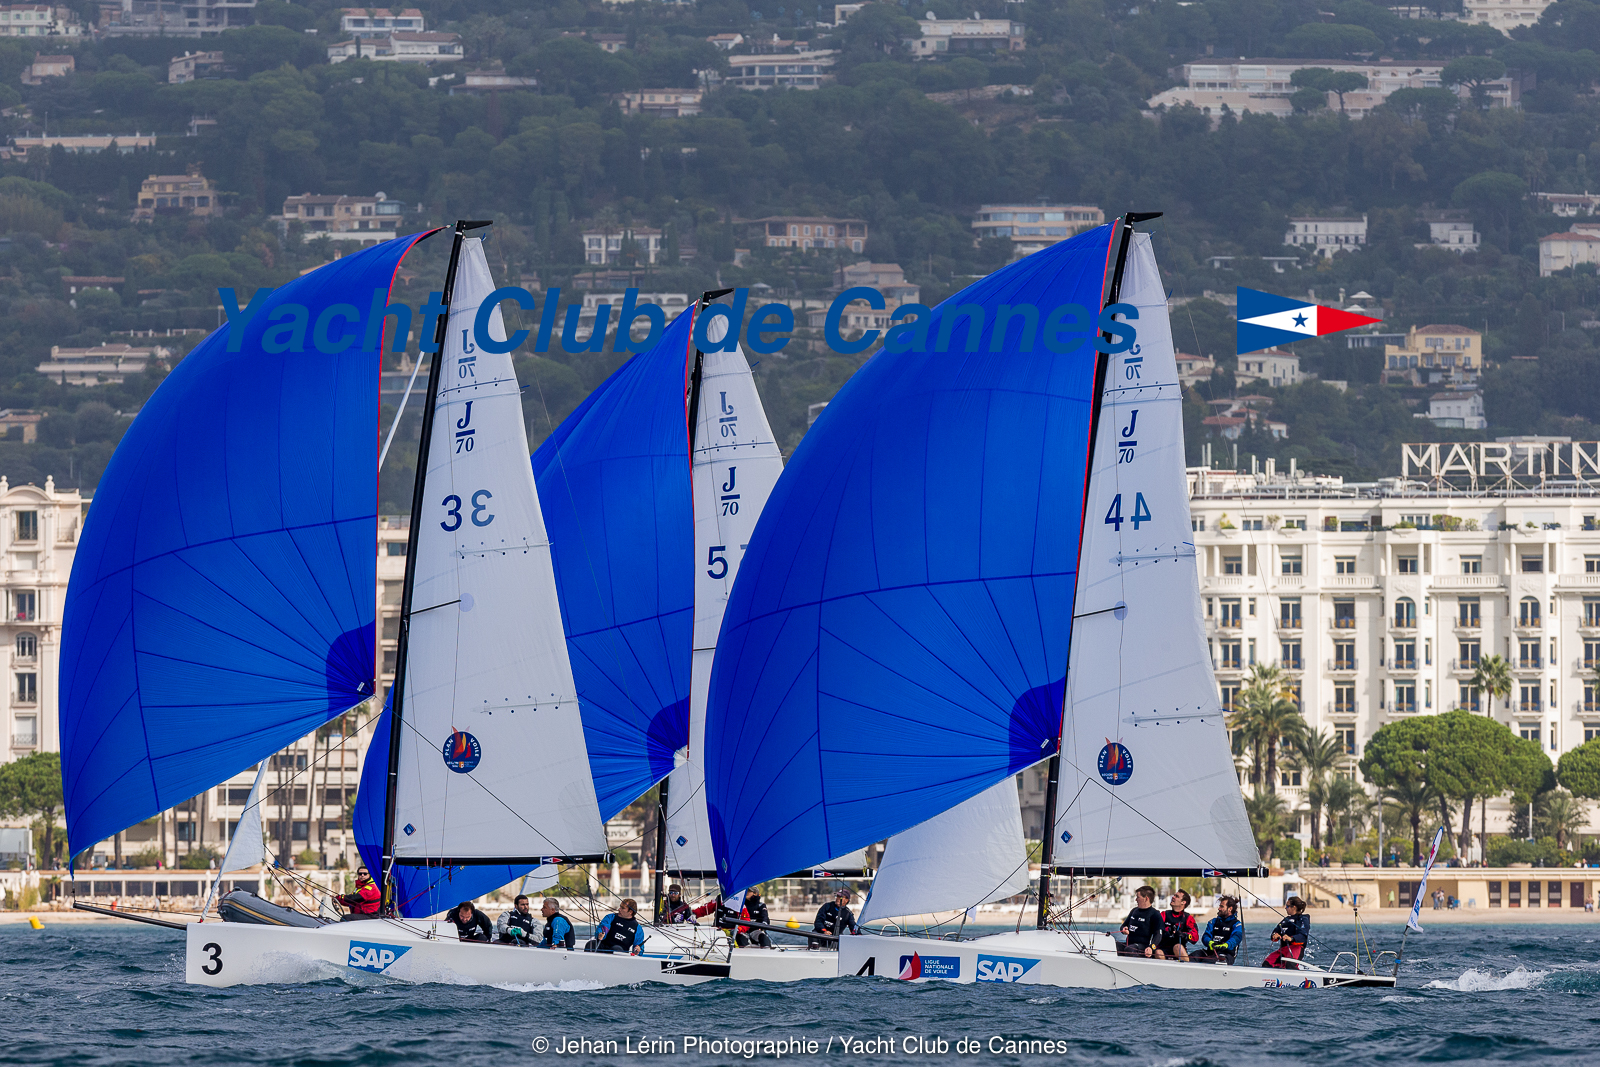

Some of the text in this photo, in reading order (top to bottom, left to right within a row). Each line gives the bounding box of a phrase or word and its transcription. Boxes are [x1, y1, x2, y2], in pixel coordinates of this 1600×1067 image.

[456, 401, 474, 430] J
[1121, 409, 1139, 438] J
[456, 437, 475, 455] 70
[1118, 448, 1136, 465] 70
[722, 465, 738, 493] J
[440, 494, 463, 533] 3
[721, 501, 740, 517] 70
[1104, 493, 1125, 533] 4
[707, 545, 729, 580] 5
[444, 737, 479, 757] PLAN VOILE
[1122, 749, 1132, 768] VOILE
[201, 942, 223, 976] 3
[349, 946, 396, 969] SAP
[977, 960, 1024, 982] SAP
